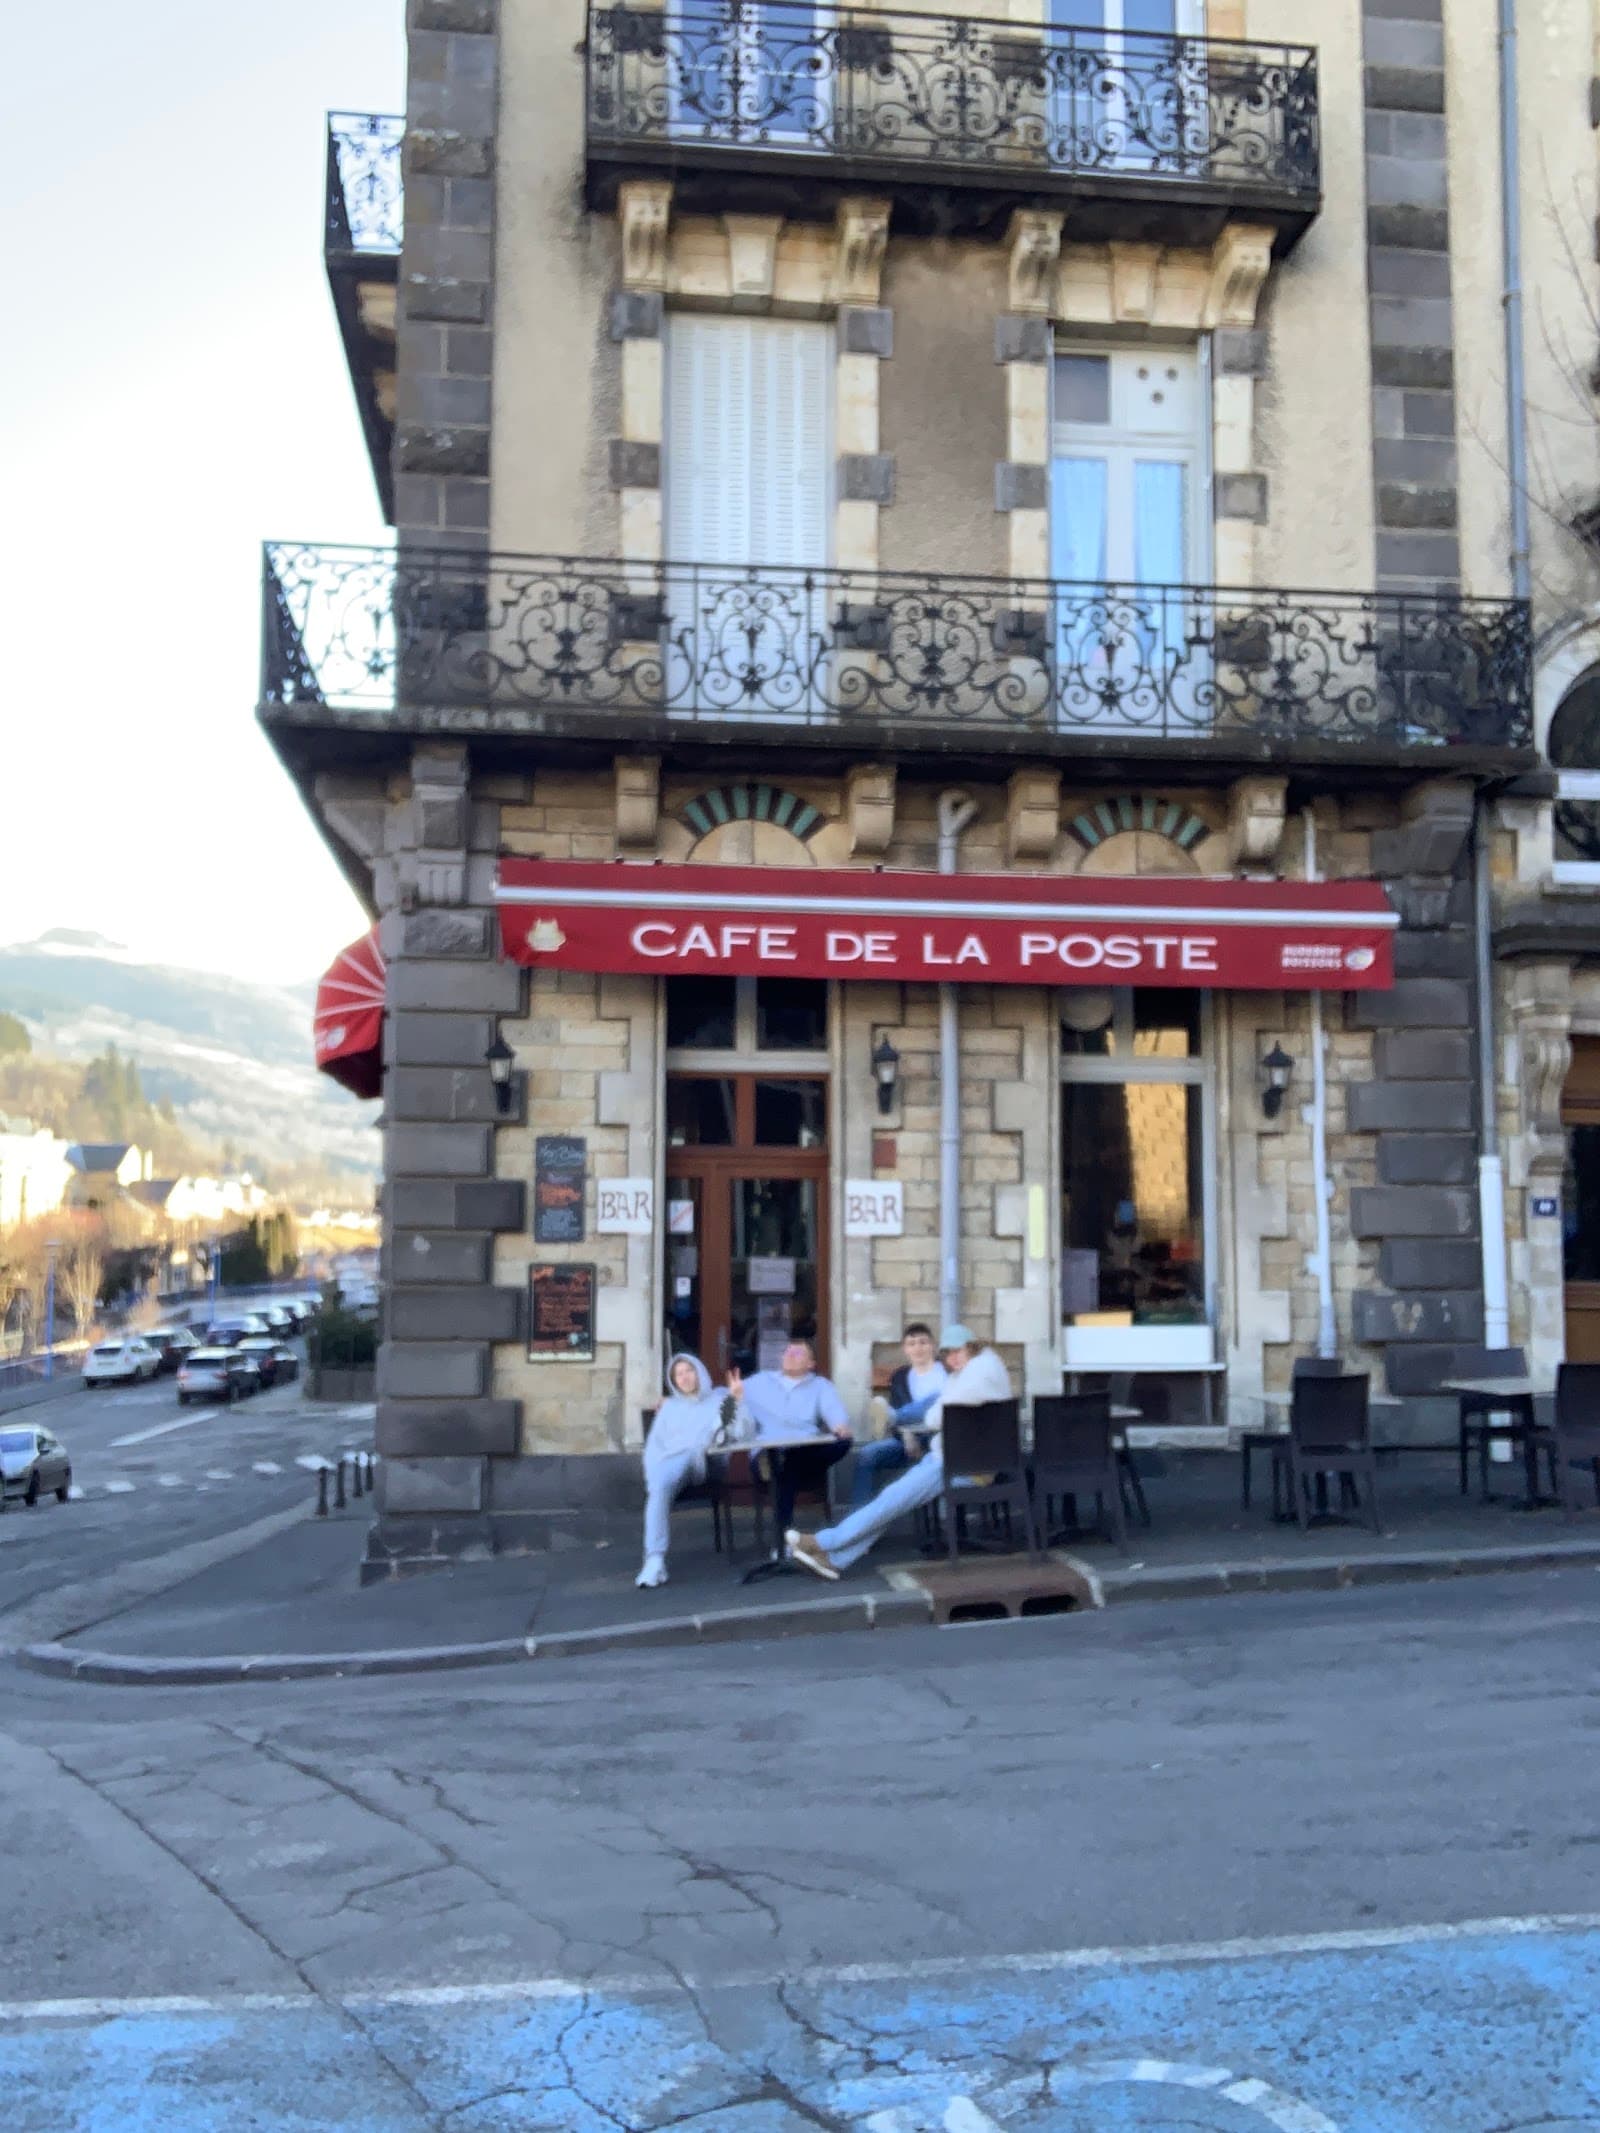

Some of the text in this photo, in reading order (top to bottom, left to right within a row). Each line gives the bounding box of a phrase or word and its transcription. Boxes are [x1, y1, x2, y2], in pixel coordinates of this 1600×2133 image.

[630, 922, 1218, 971] CAFE DE LA POSTE
[600, 1191, 651, 1219] BAR
[847, 1194, 898, 1222] BAR
